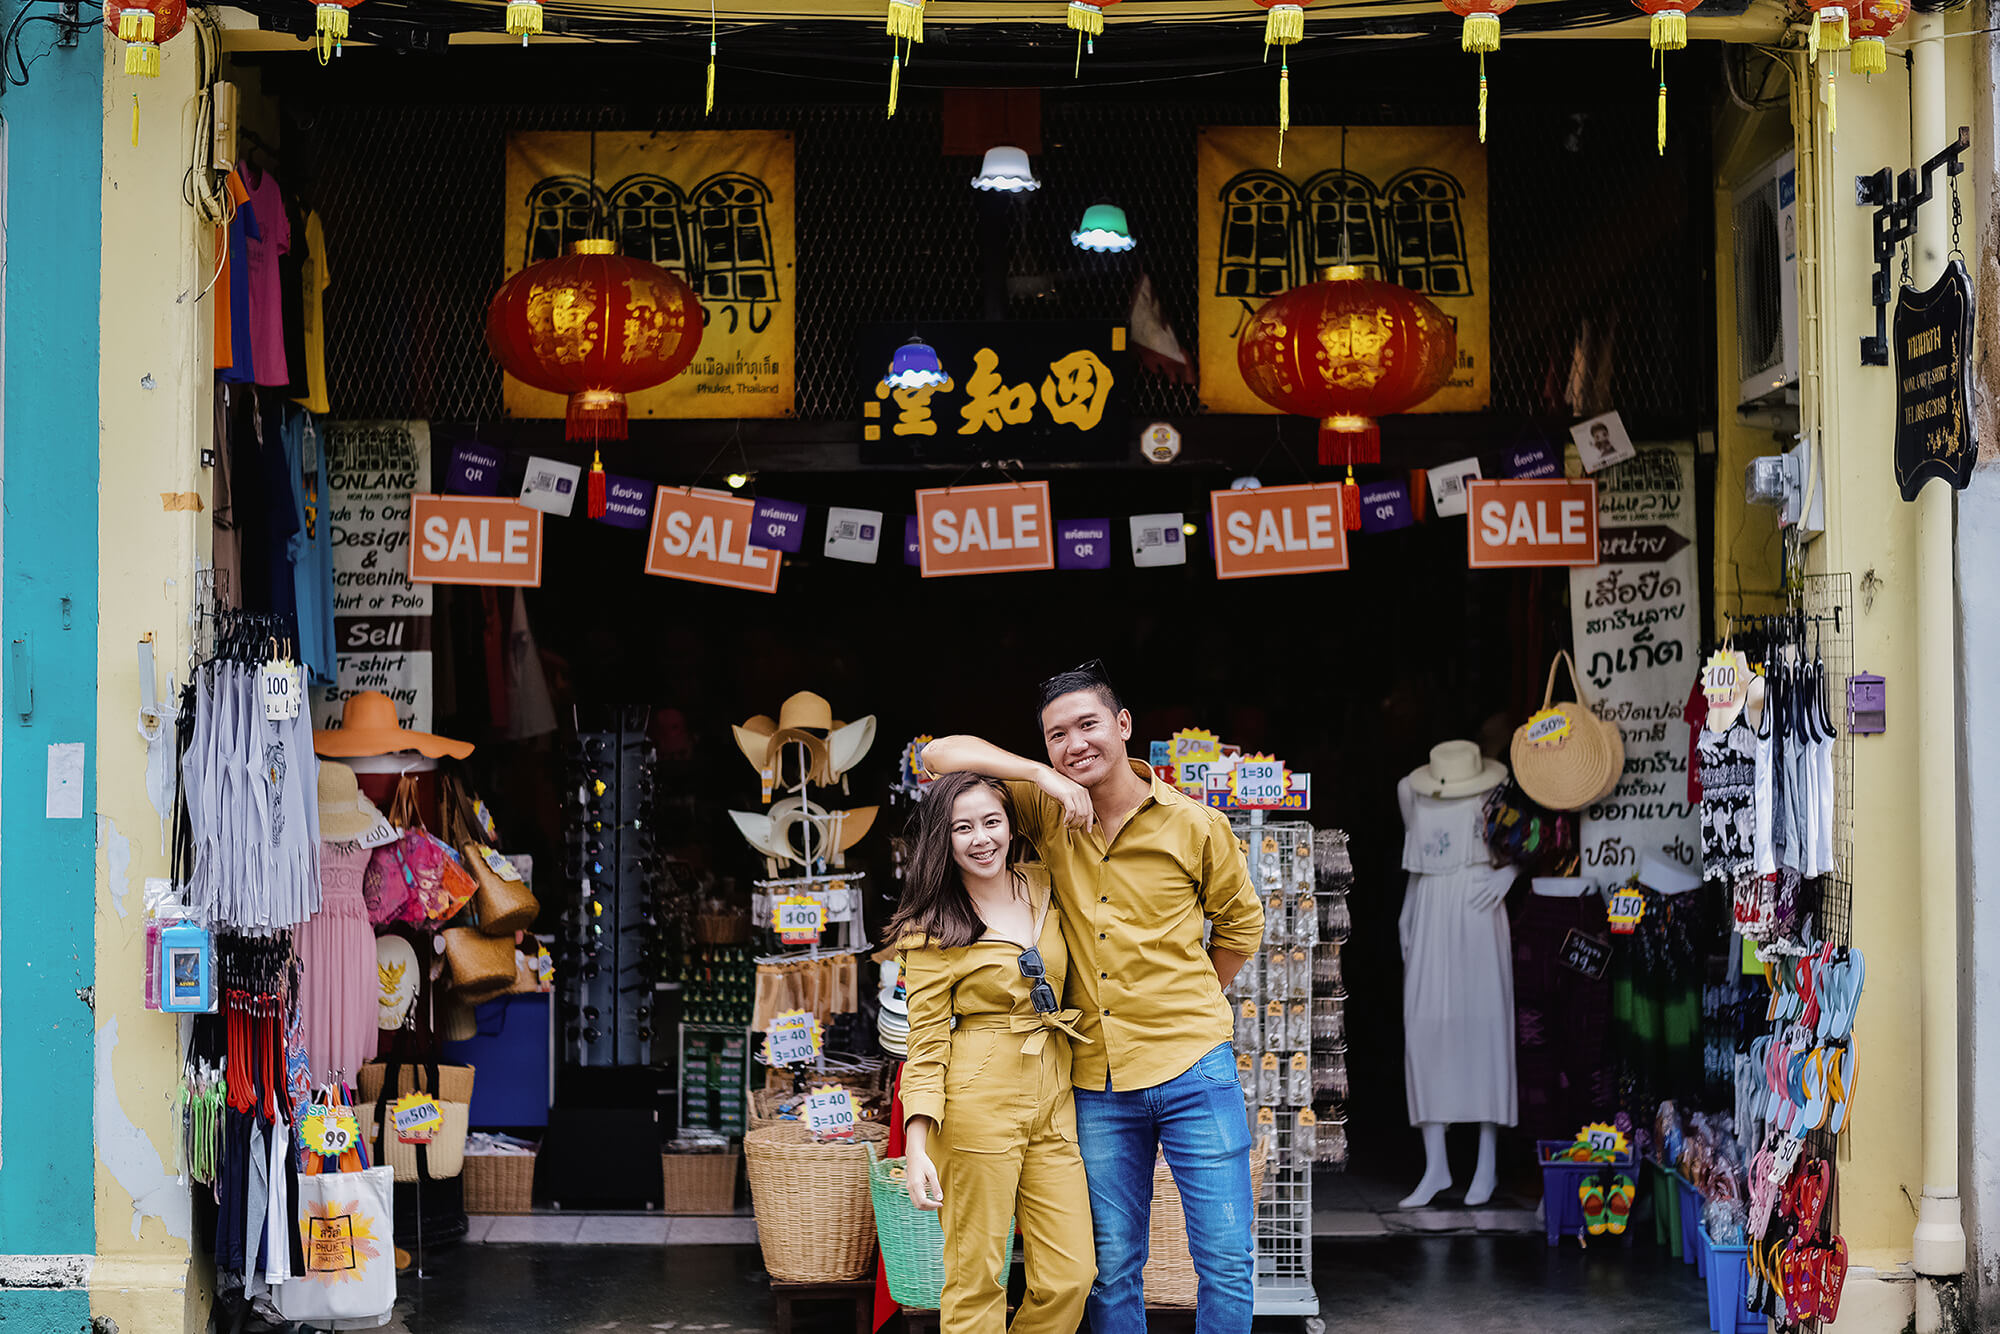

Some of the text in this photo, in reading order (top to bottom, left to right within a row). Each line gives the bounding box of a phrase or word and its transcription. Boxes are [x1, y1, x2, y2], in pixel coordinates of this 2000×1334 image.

[736, 383, 779, 394] Thailand
[465, 468, 483, 481] QR
[360, 506, 375, 521] to
[1376, 505, 1395, 520] QR
[768, 524, 786, 537] QR
[932, 504, 1039, 554] SALE
[1226, 505, 1335, 556] SALE
[1480, 500, 1587, 546] SALE
[422, 515, 529, 564] SALE
[361, 550, 378, 568] &
[1075, 544, 1093, 557] QR
[1585, 570, 1681, 608] เสื้อยืด
[369, 598, 384, 609] or
[392, 593, 424, 608] Polo
[347, 621, 404, 646] Sell
[337, 654, 406, 673] T-shirt
[1587, 625, 1683, 689] ภูเก็ต
[1707, 667, 1735, 686] 100
[267, 677, 288, 695] 100
[1185, 764, 1209, 781] 50
[1241, 766, 1273, 779] 1=30
[1240, 785, 1281, 797] 4=100
[1211, 795, 1219, 806] 3
[1589, 801, 1695, 821] ออกแบบ
[1611, 898, 1641, 916] 150
[785, 911, 817, 924] 100
[791, 1029, 806, 1041] 40
[775, 1045, 813, 1062] 3=100
[829, 1093, 845, 1106] 40
[812, 1111, 853, 1128] 3=100
[325, 1131, 347, 1147] 99
[1591, 1134, 1615, 1152] 50
[1781, 1139, 1797, 1161] 50
